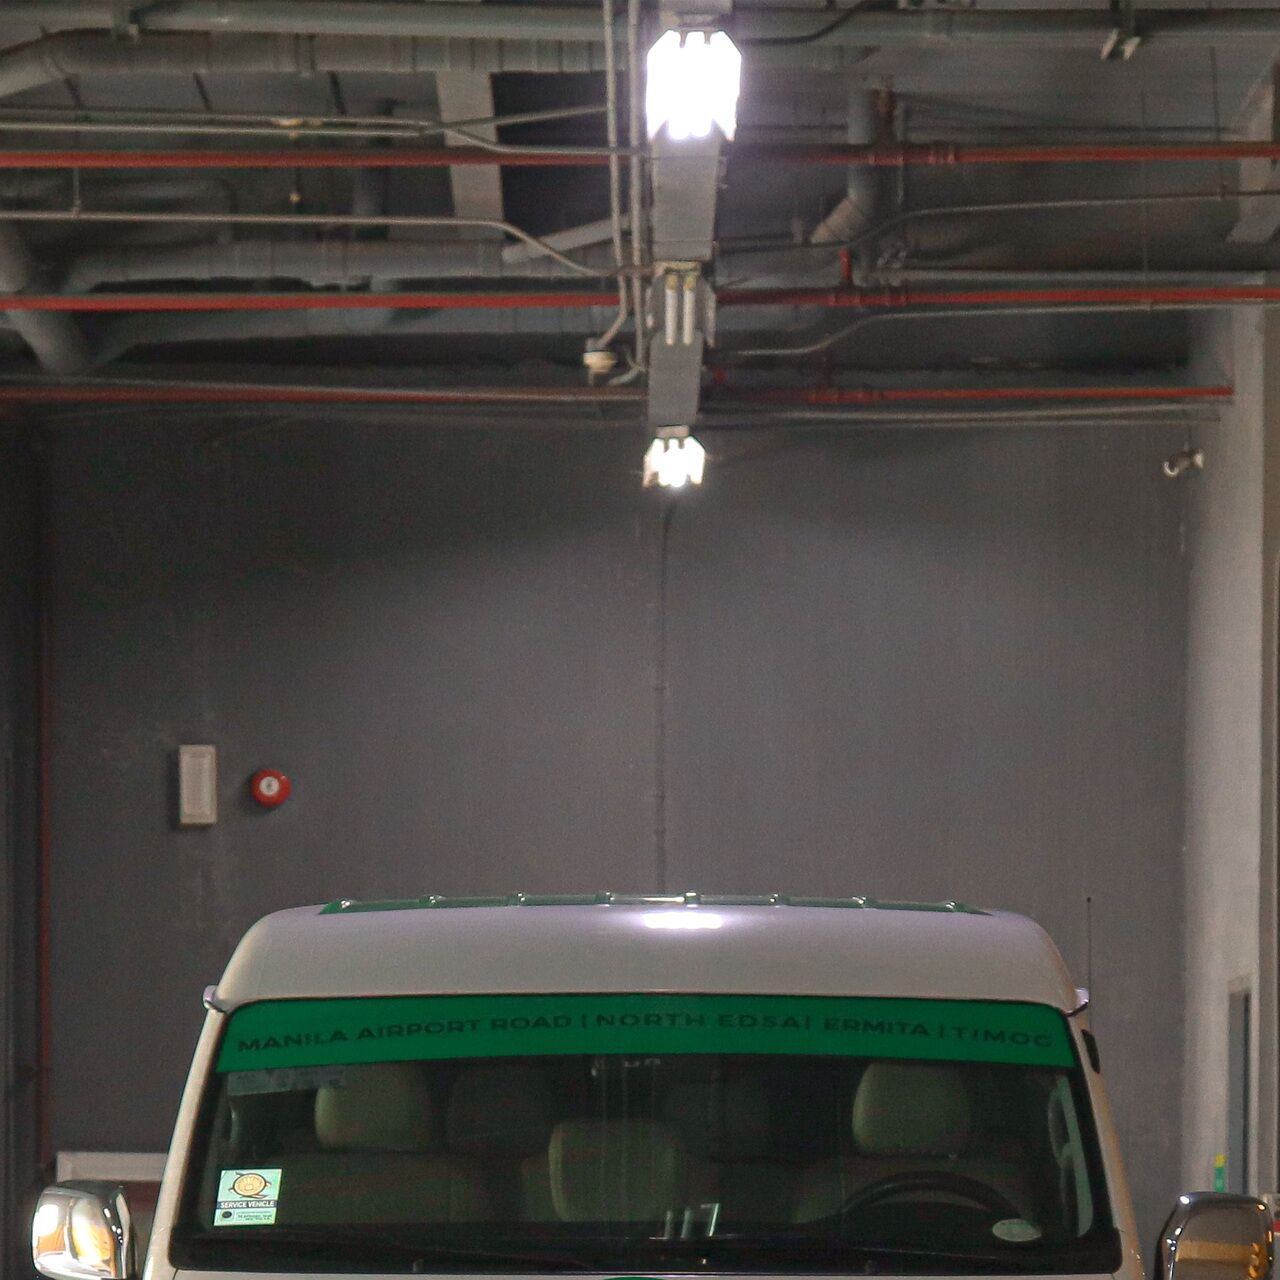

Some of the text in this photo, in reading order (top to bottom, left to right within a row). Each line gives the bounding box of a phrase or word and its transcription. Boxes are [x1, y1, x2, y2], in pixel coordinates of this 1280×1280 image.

[238, 1029, 349, 1051] MANILA
[357, 1019, 481, 1040] AIRPORT
[490, 1014, 572, 1030] ROAD
[596, 1013, 706, 1028] NORTH
[823, 1017, 929, 1036] ERMITA
[220, 1200, 275, 1209] SERVICE VEHICLE
